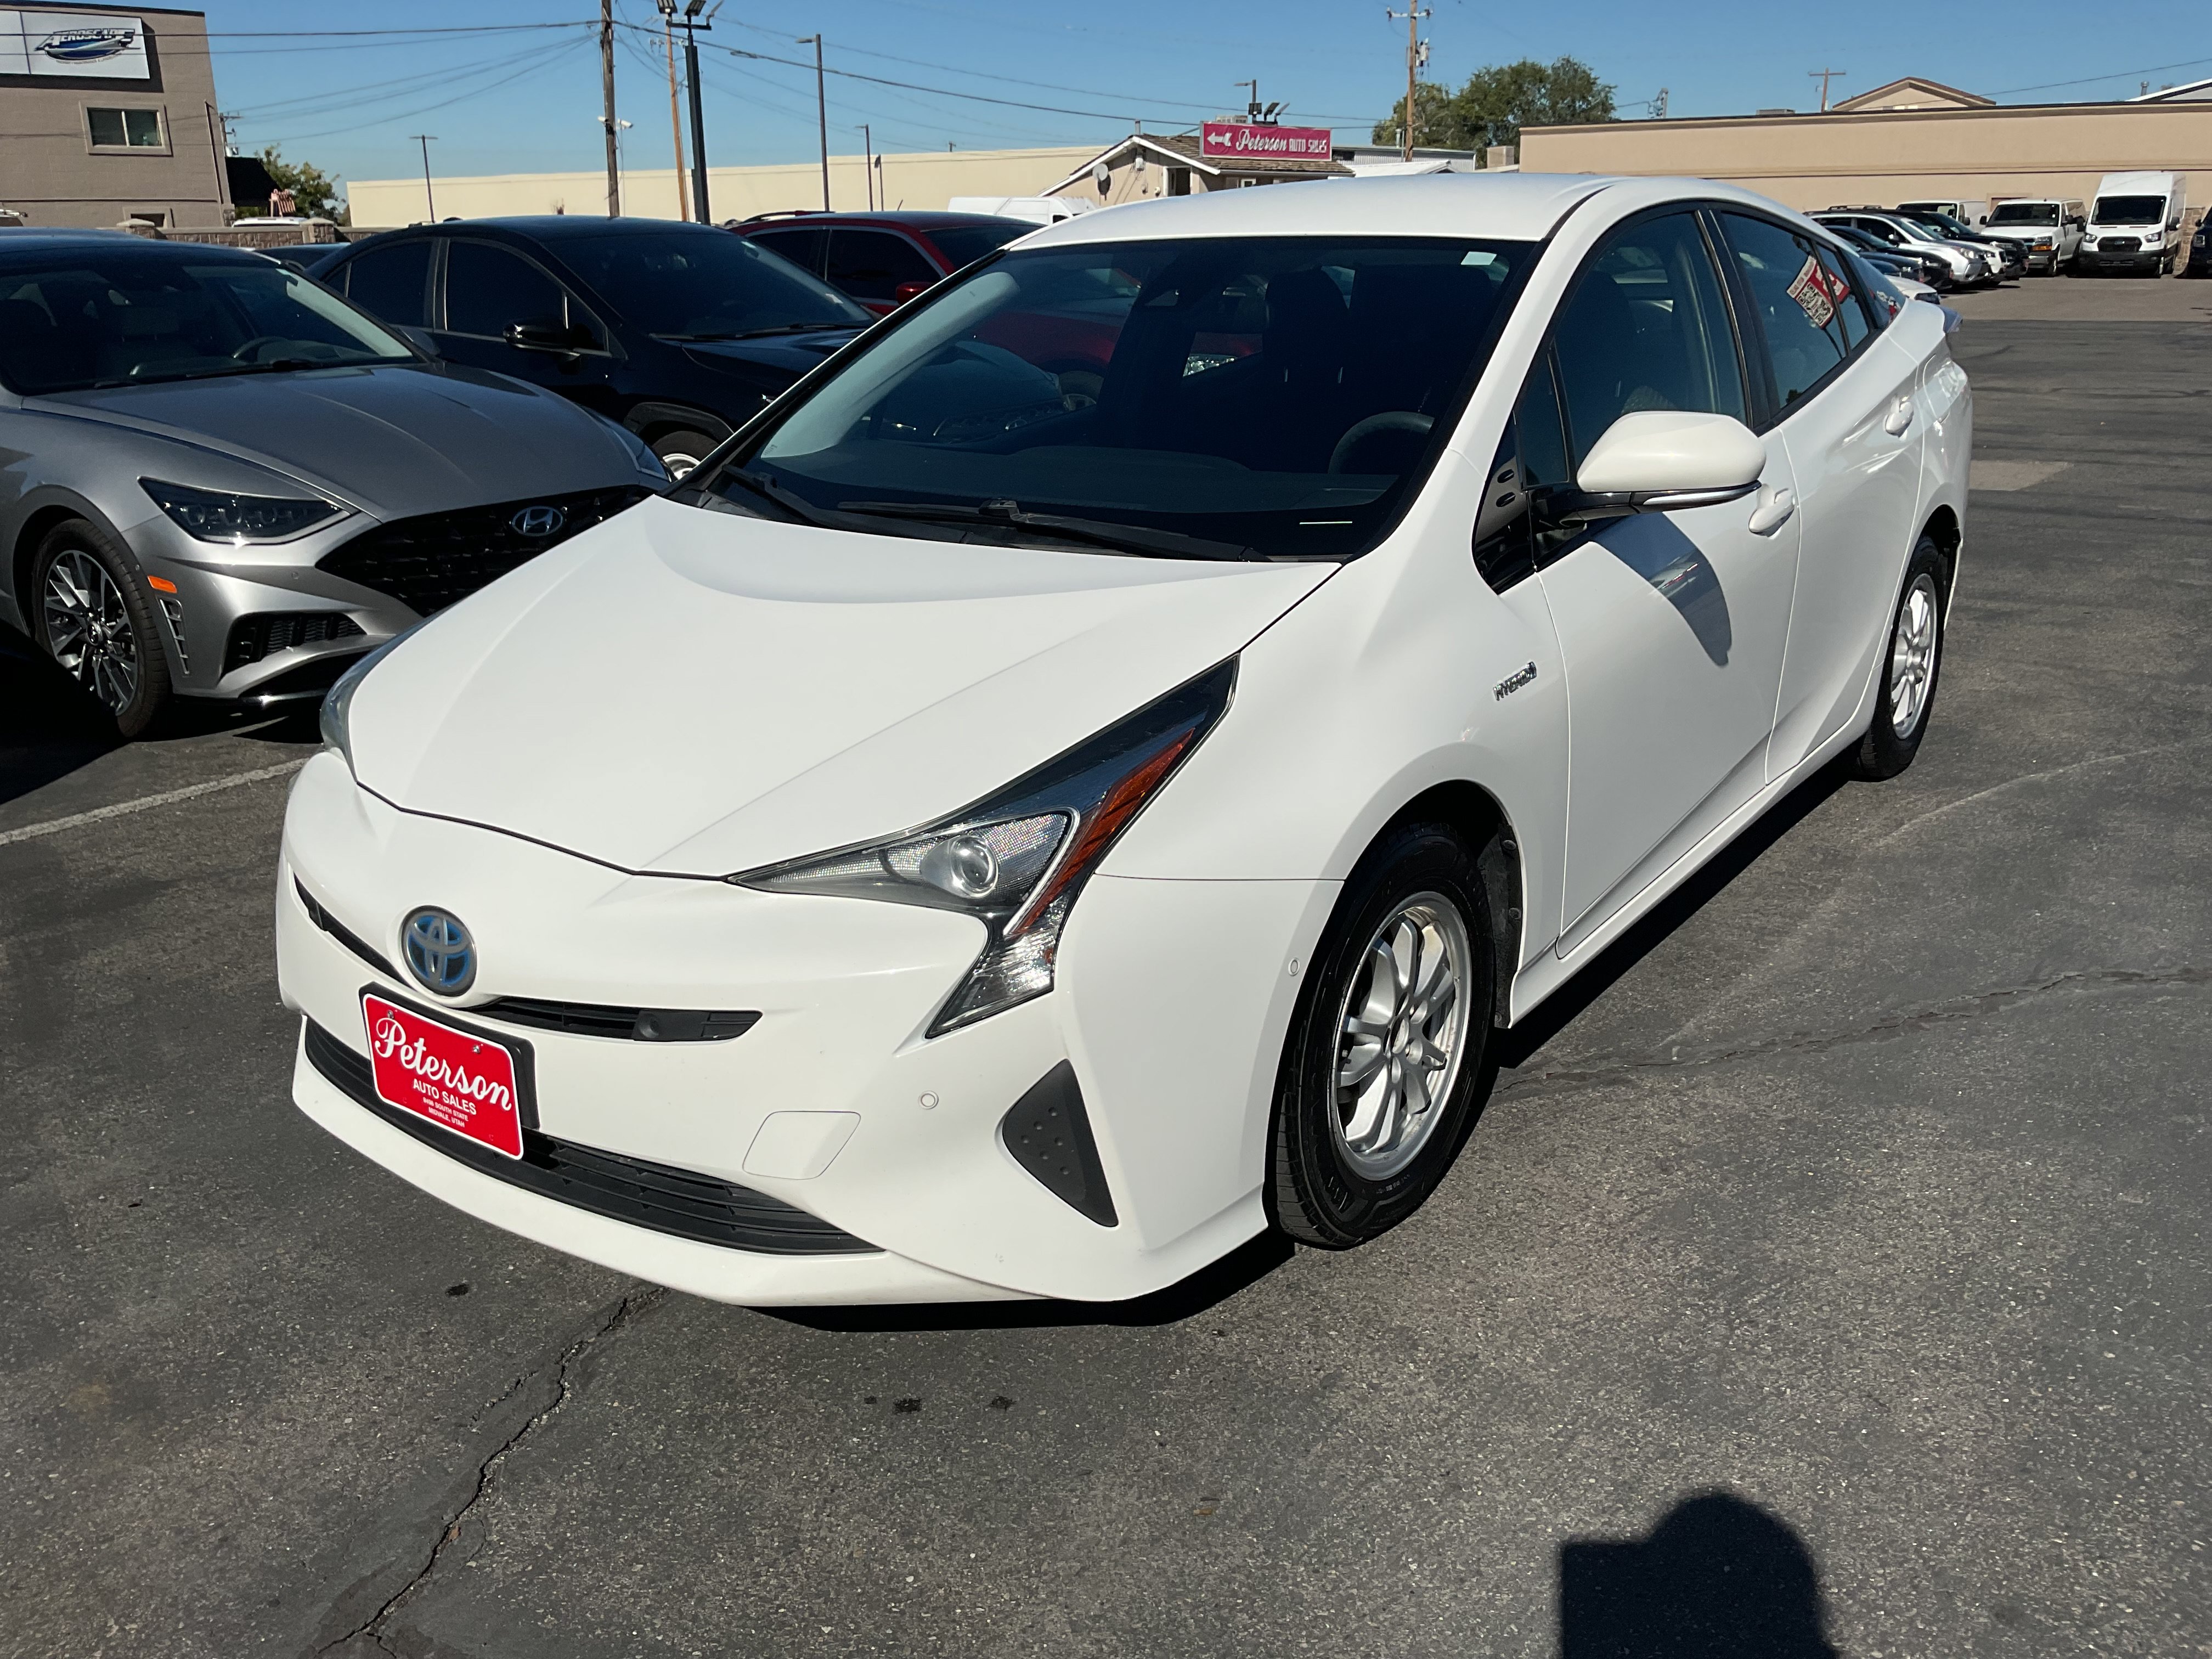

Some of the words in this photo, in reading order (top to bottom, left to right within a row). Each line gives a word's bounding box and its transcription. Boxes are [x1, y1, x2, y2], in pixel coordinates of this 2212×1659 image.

[1235, 128, 1288, 151] Peterson
[1289, 138, 1306, 152] AUTO
[1308, 139, 1327, 153] SALES
[375, 1018, 512, 1111] Peterson
[413, 1078, 439, 1099] AUTO
[443, 1091, 477, 1115] SALES
[435, 1102, 452, 1114] SOUTH
[453, 1110, 469, 1121] STATE
[452, 1116, 465, 1127] UTAH
